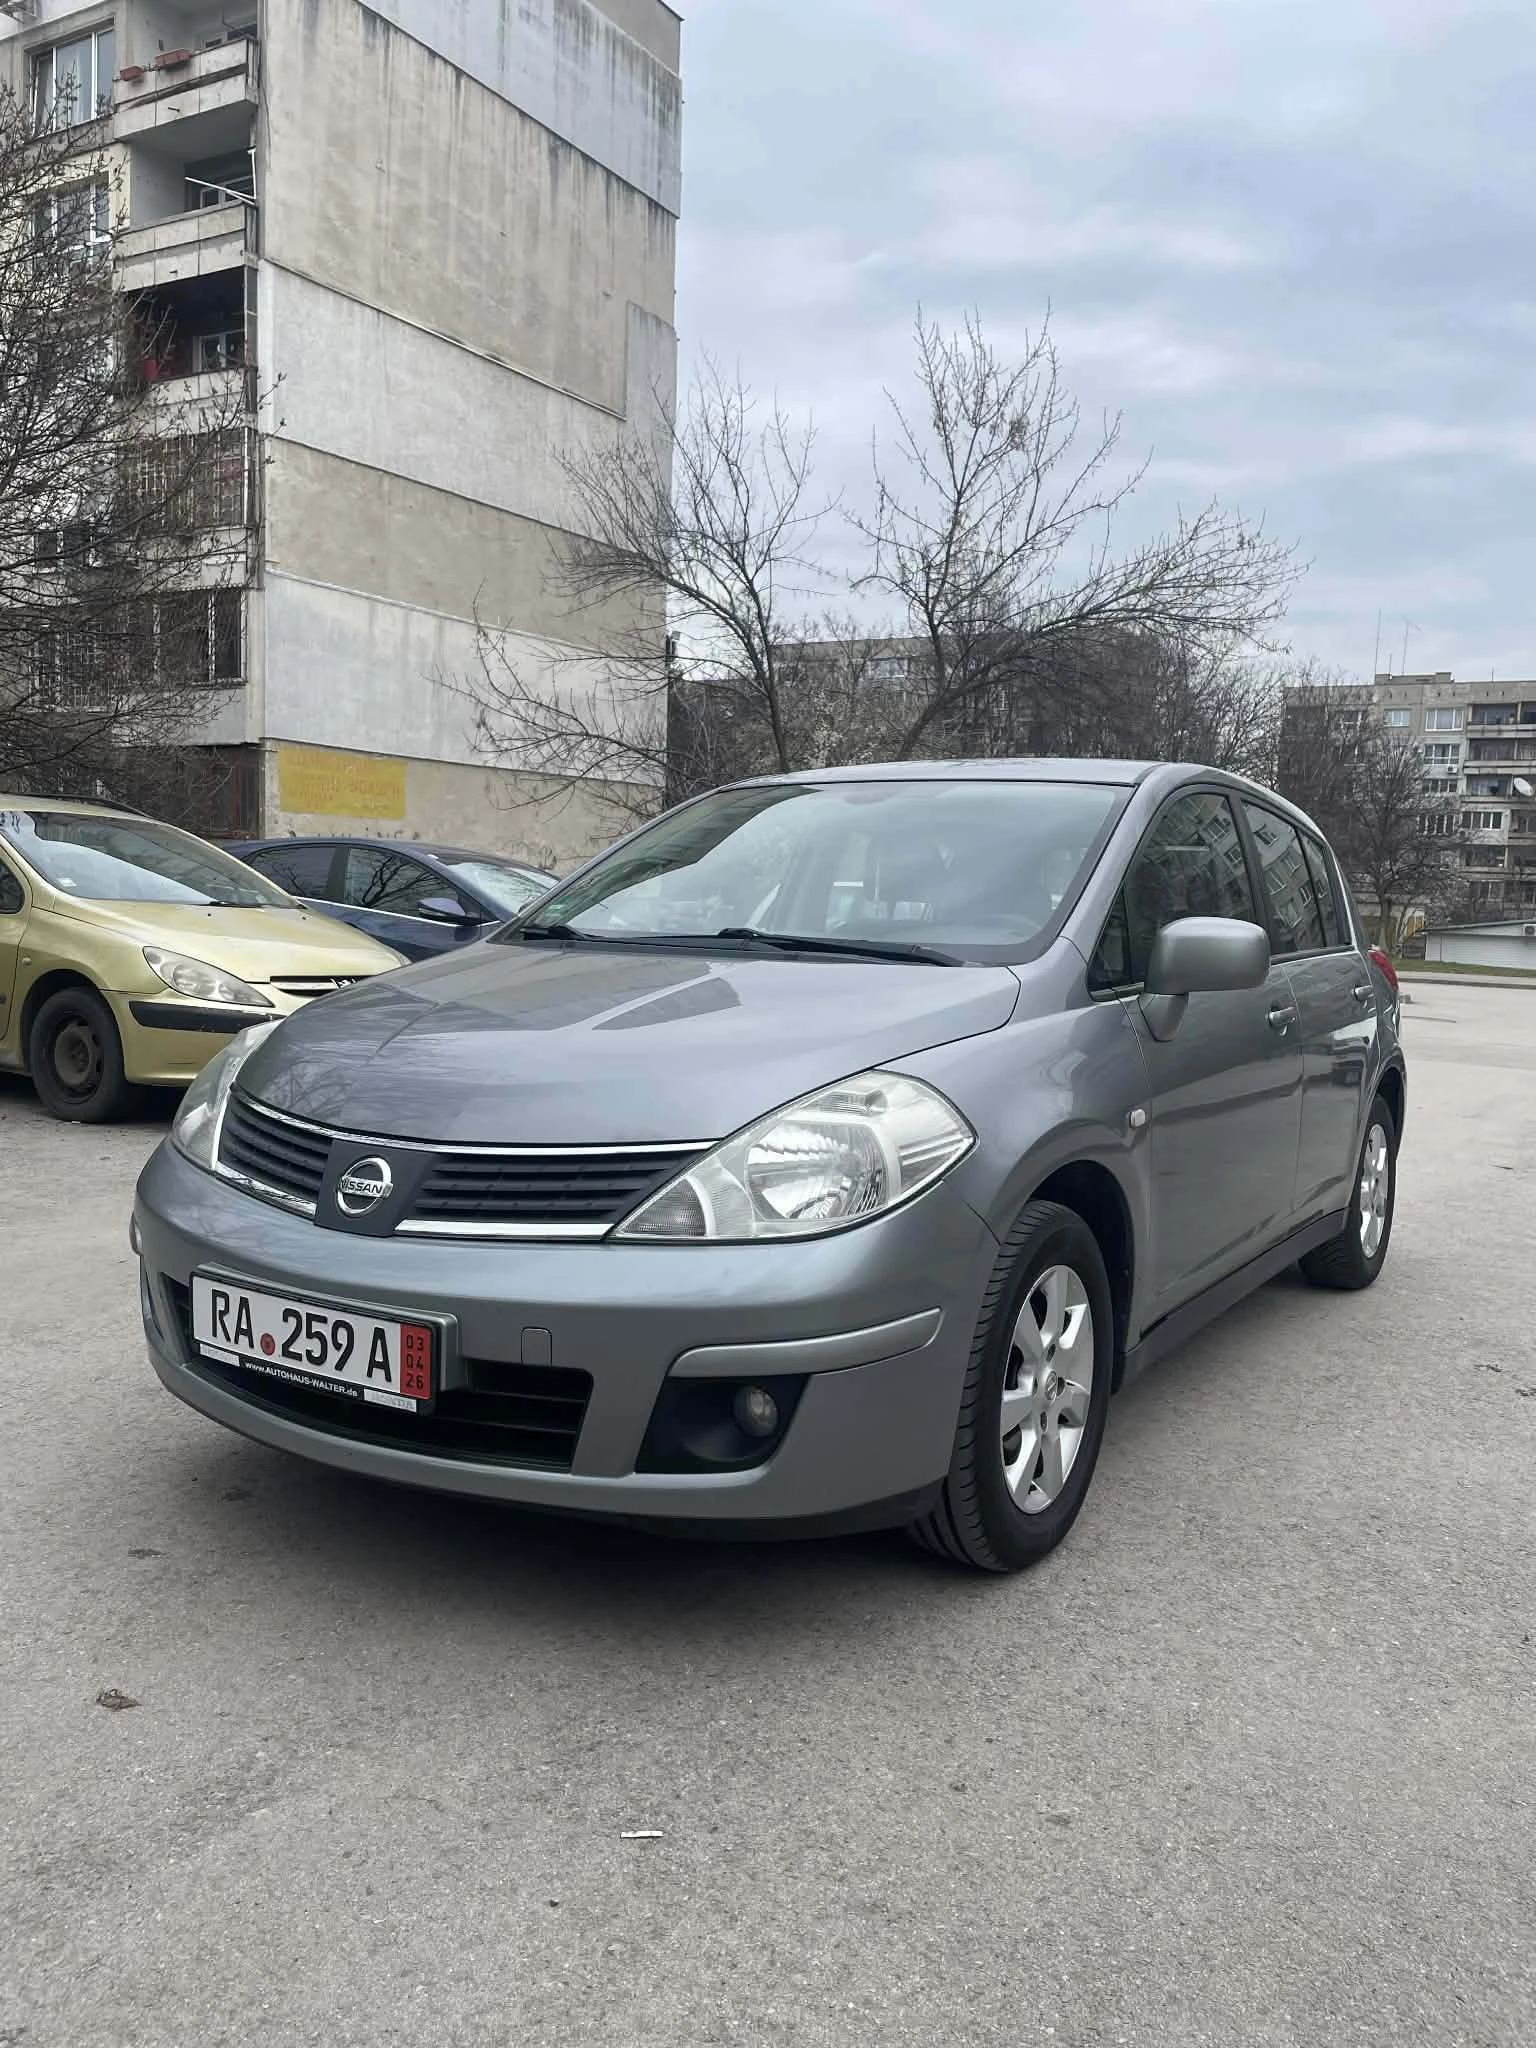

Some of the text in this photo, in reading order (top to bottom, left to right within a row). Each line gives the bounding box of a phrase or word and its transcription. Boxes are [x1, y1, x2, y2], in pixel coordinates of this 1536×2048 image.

[341, 1178, 383, 1194] NISSAN
[210, 1288, 393, 1383] RA 259 A
[406, 1334, 424, 1351] 03
[406, 1353, 424, 1369] 04
[244, 1361, 358, 1397] www.AUTOHAUS-WALTER.de
[406, 1372, 424, 1389] 26
